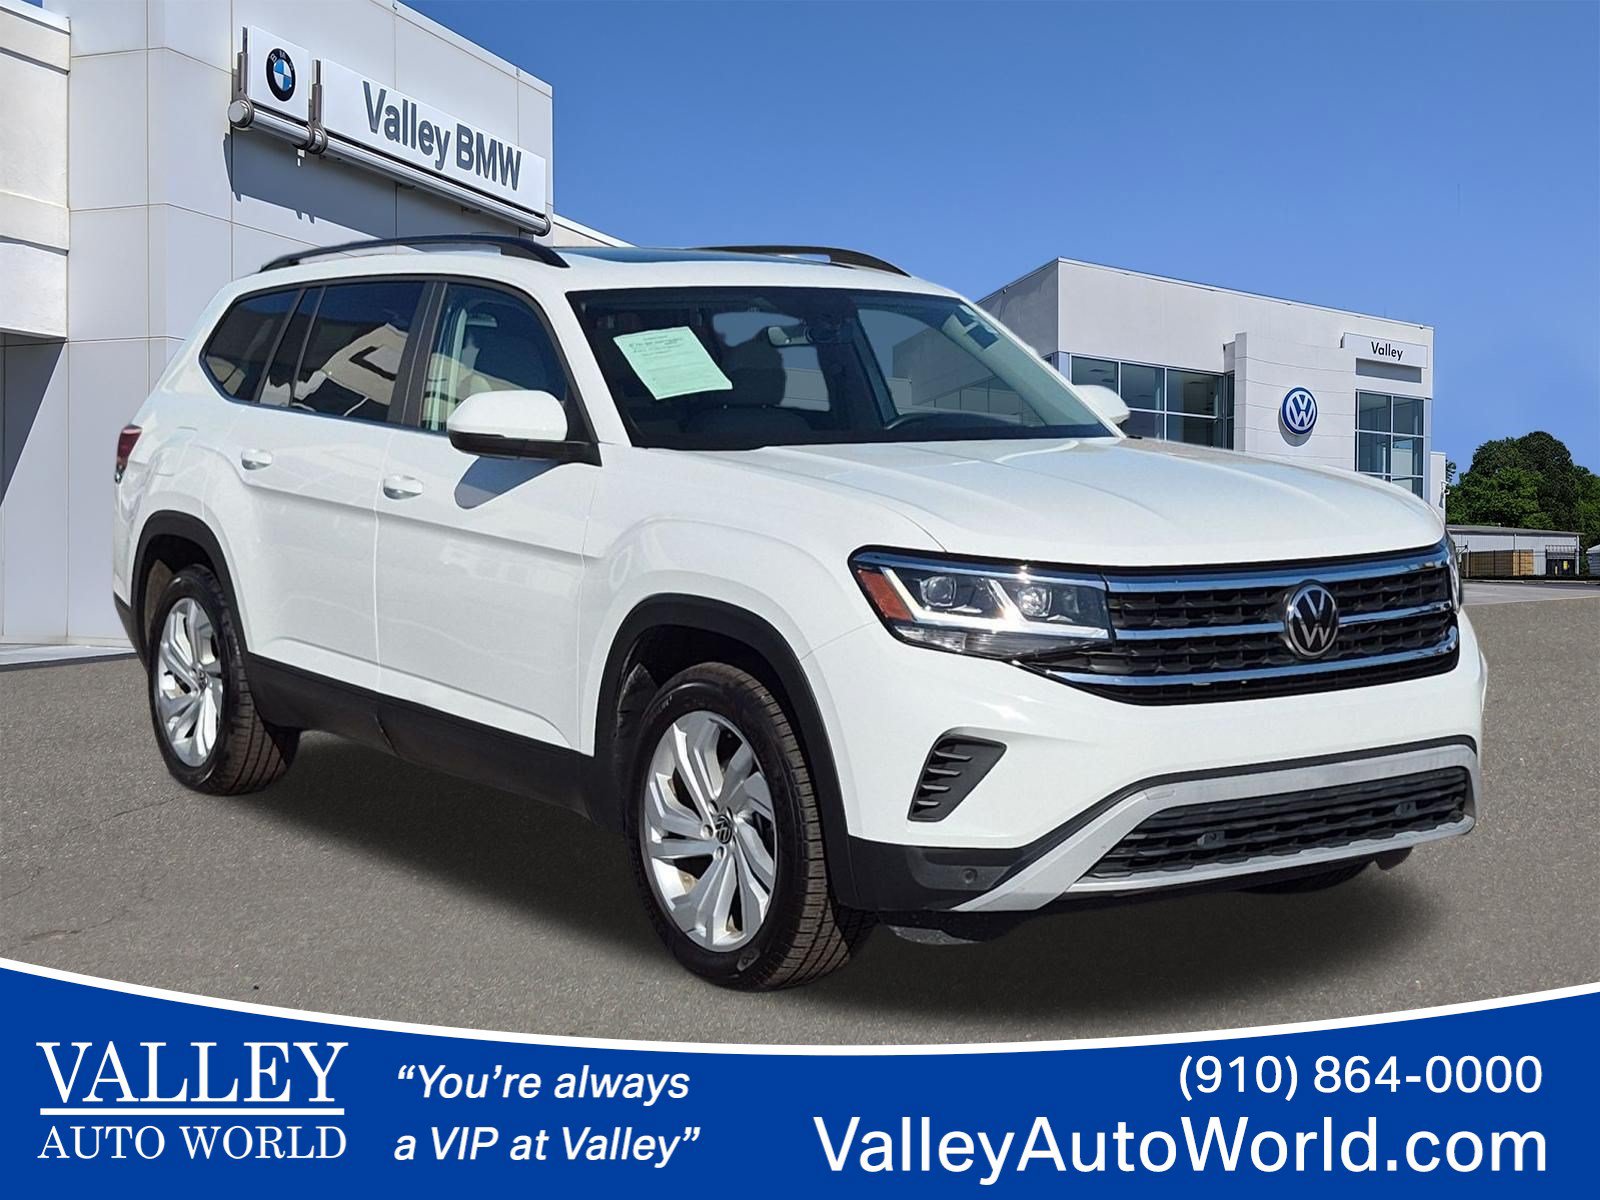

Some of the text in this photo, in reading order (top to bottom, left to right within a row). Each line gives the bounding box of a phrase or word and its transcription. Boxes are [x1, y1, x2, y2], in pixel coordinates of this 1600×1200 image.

[362, 80, 522, 191] Valley BMW
[1371, 341, 1403, 361] Valley
